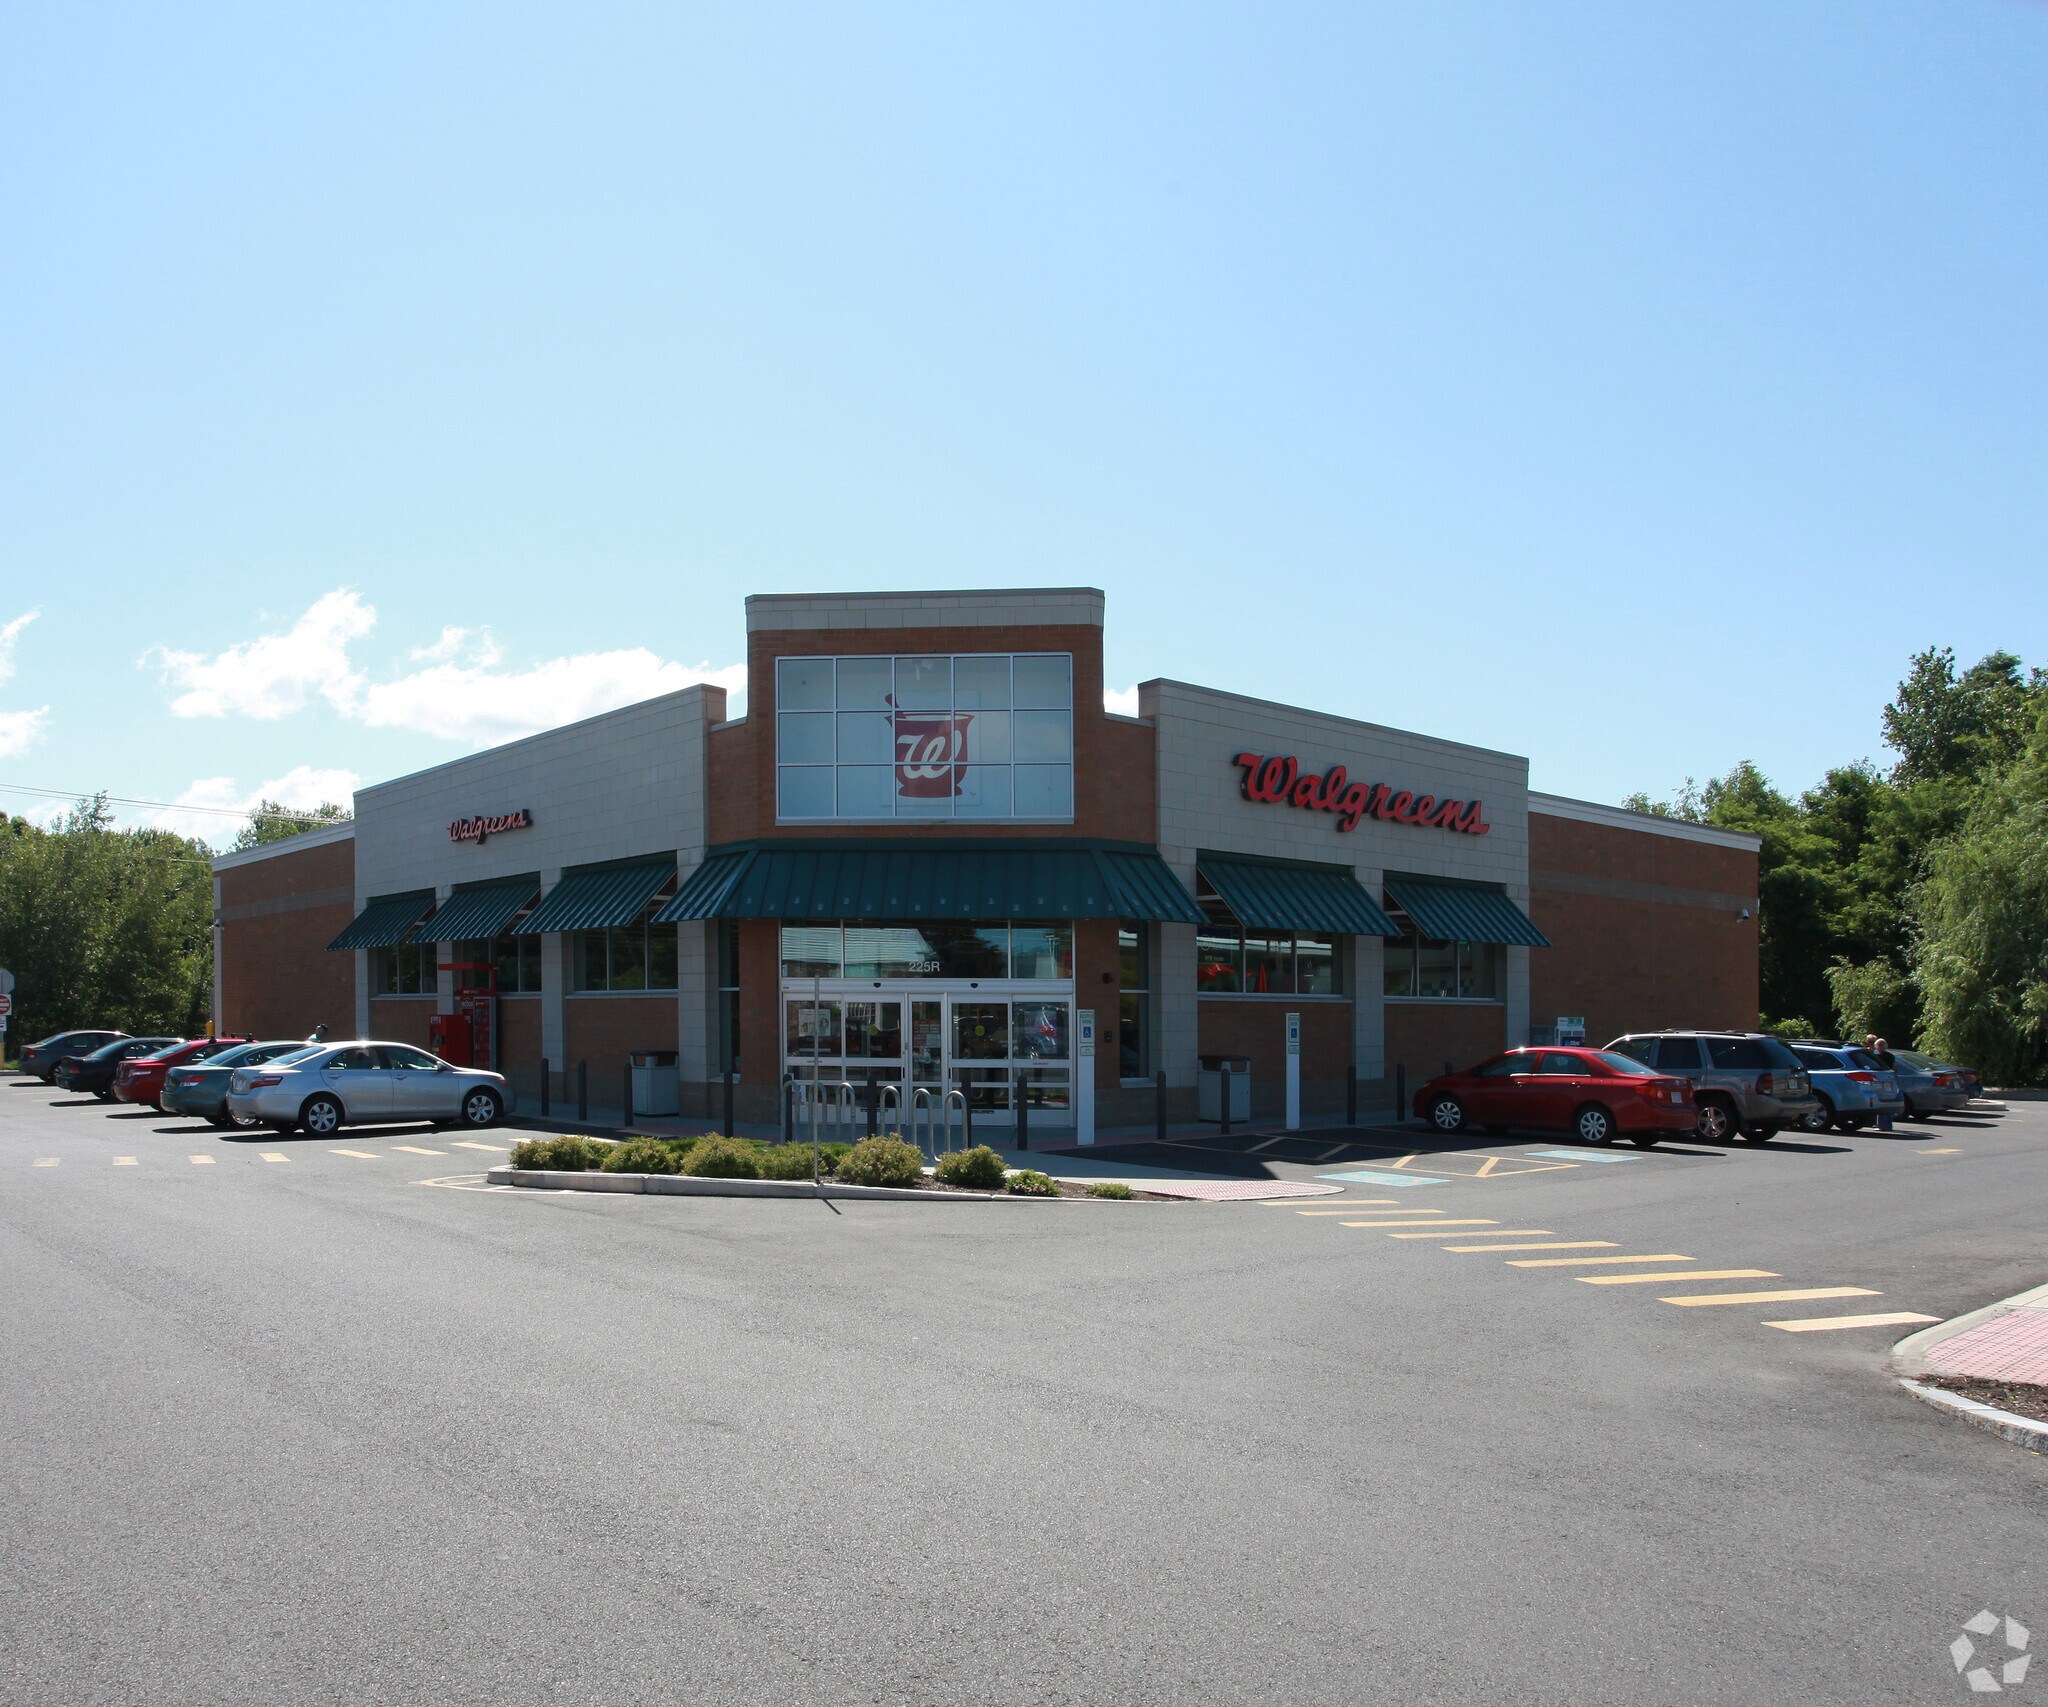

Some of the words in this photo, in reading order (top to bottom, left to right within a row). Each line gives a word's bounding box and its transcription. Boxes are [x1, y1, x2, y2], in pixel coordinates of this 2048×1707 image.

[1233, 752, 1490, 834] Walgreens
[447, 809, 530, 845] Walgreens
[908, 961, 940, 972] 225R
